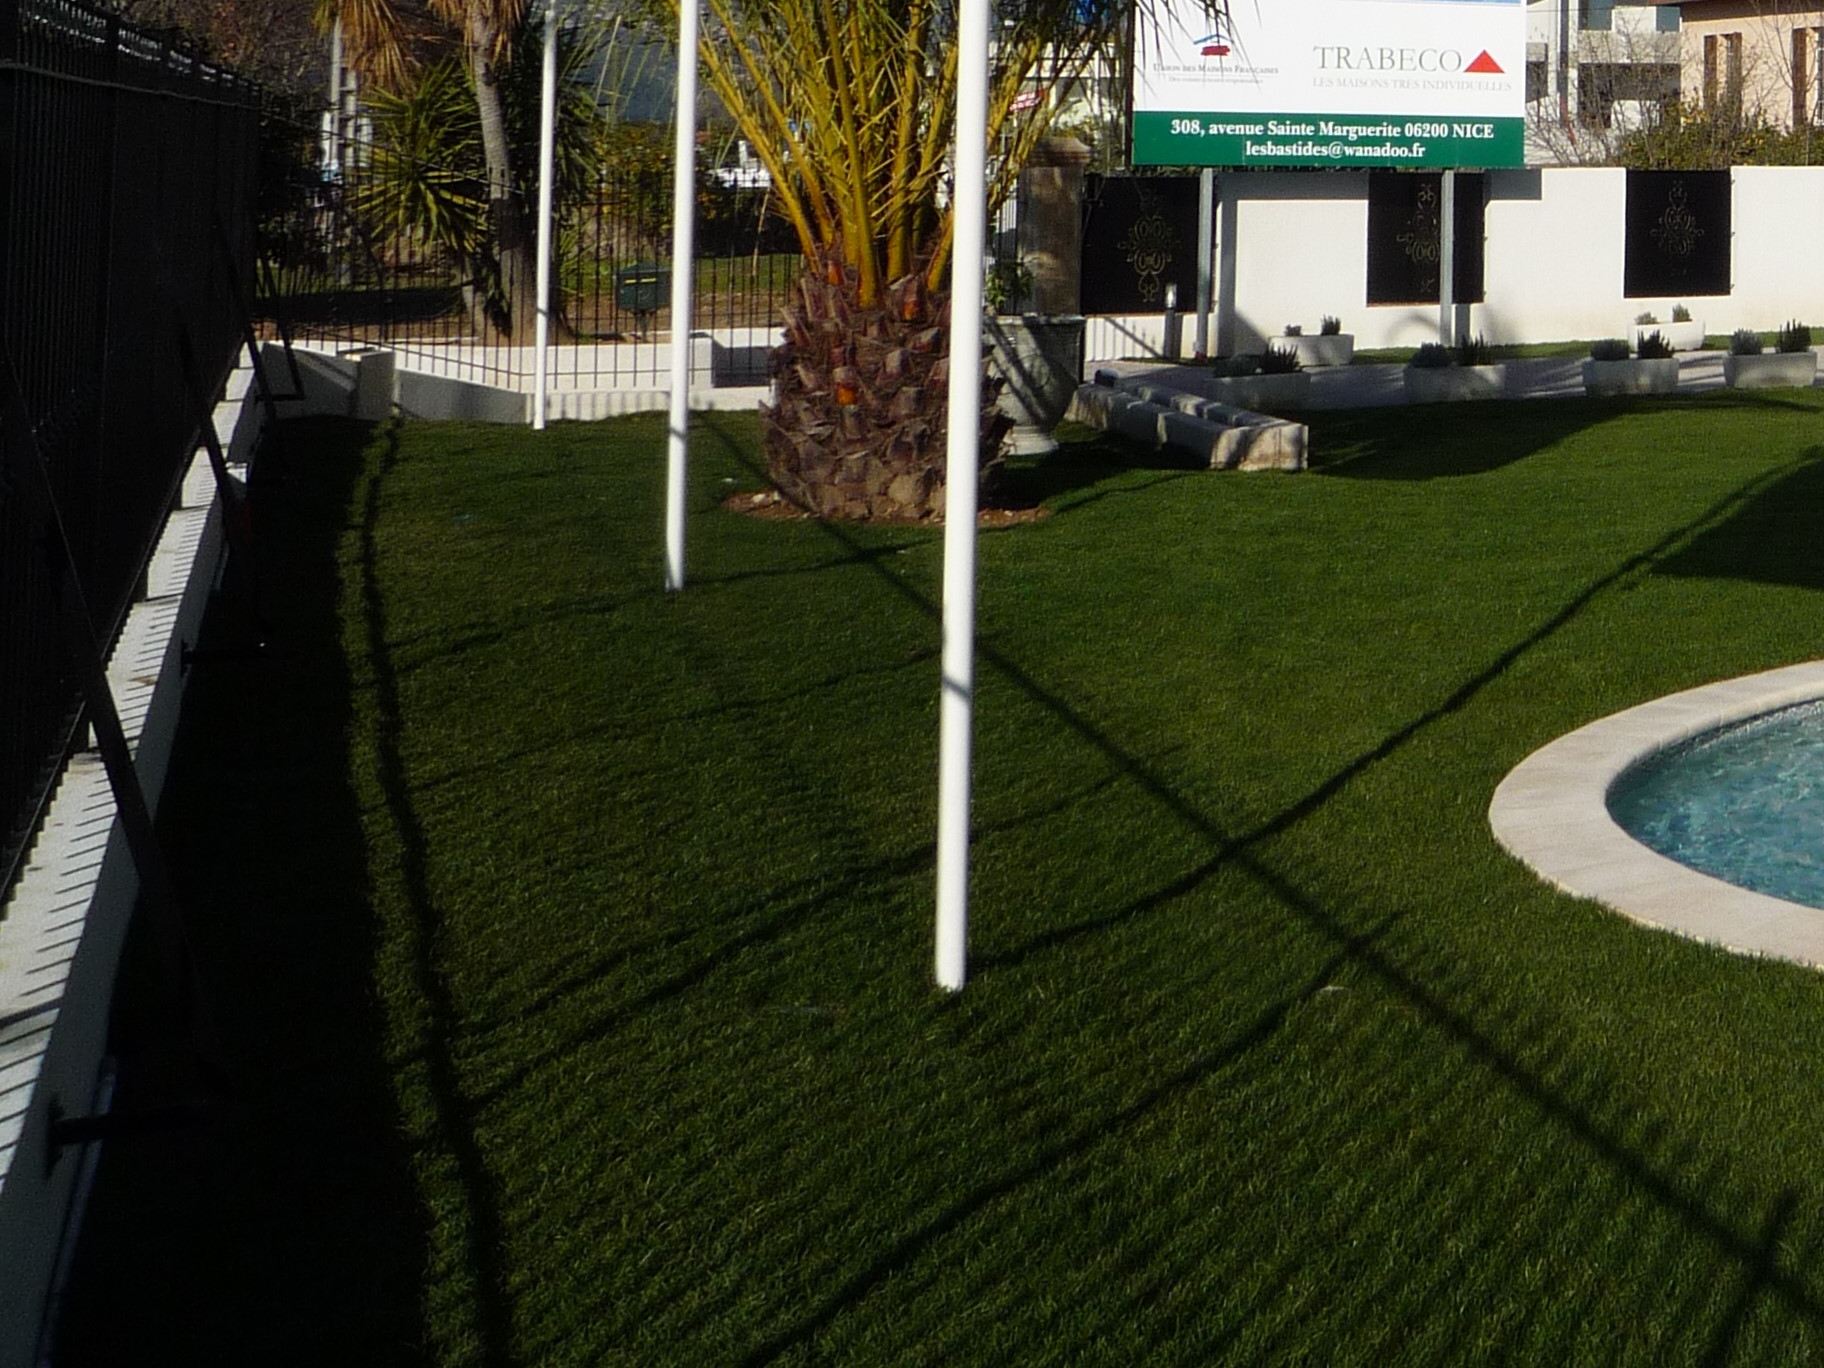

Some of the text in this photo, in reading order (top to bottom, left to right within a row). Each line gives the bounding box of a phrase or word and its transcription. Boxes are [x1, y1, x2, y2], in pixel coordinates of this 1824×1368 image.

[1313, 45, 1463, 73] TRABECO
[1336, 77, 1390, 90] MAISONS
[1170, 119, 1495, 141] 308, avenue Sainte Marguerite 06200 NICE
[1245, 140, 1426, 159] lesbastides@wanadoo.fr
